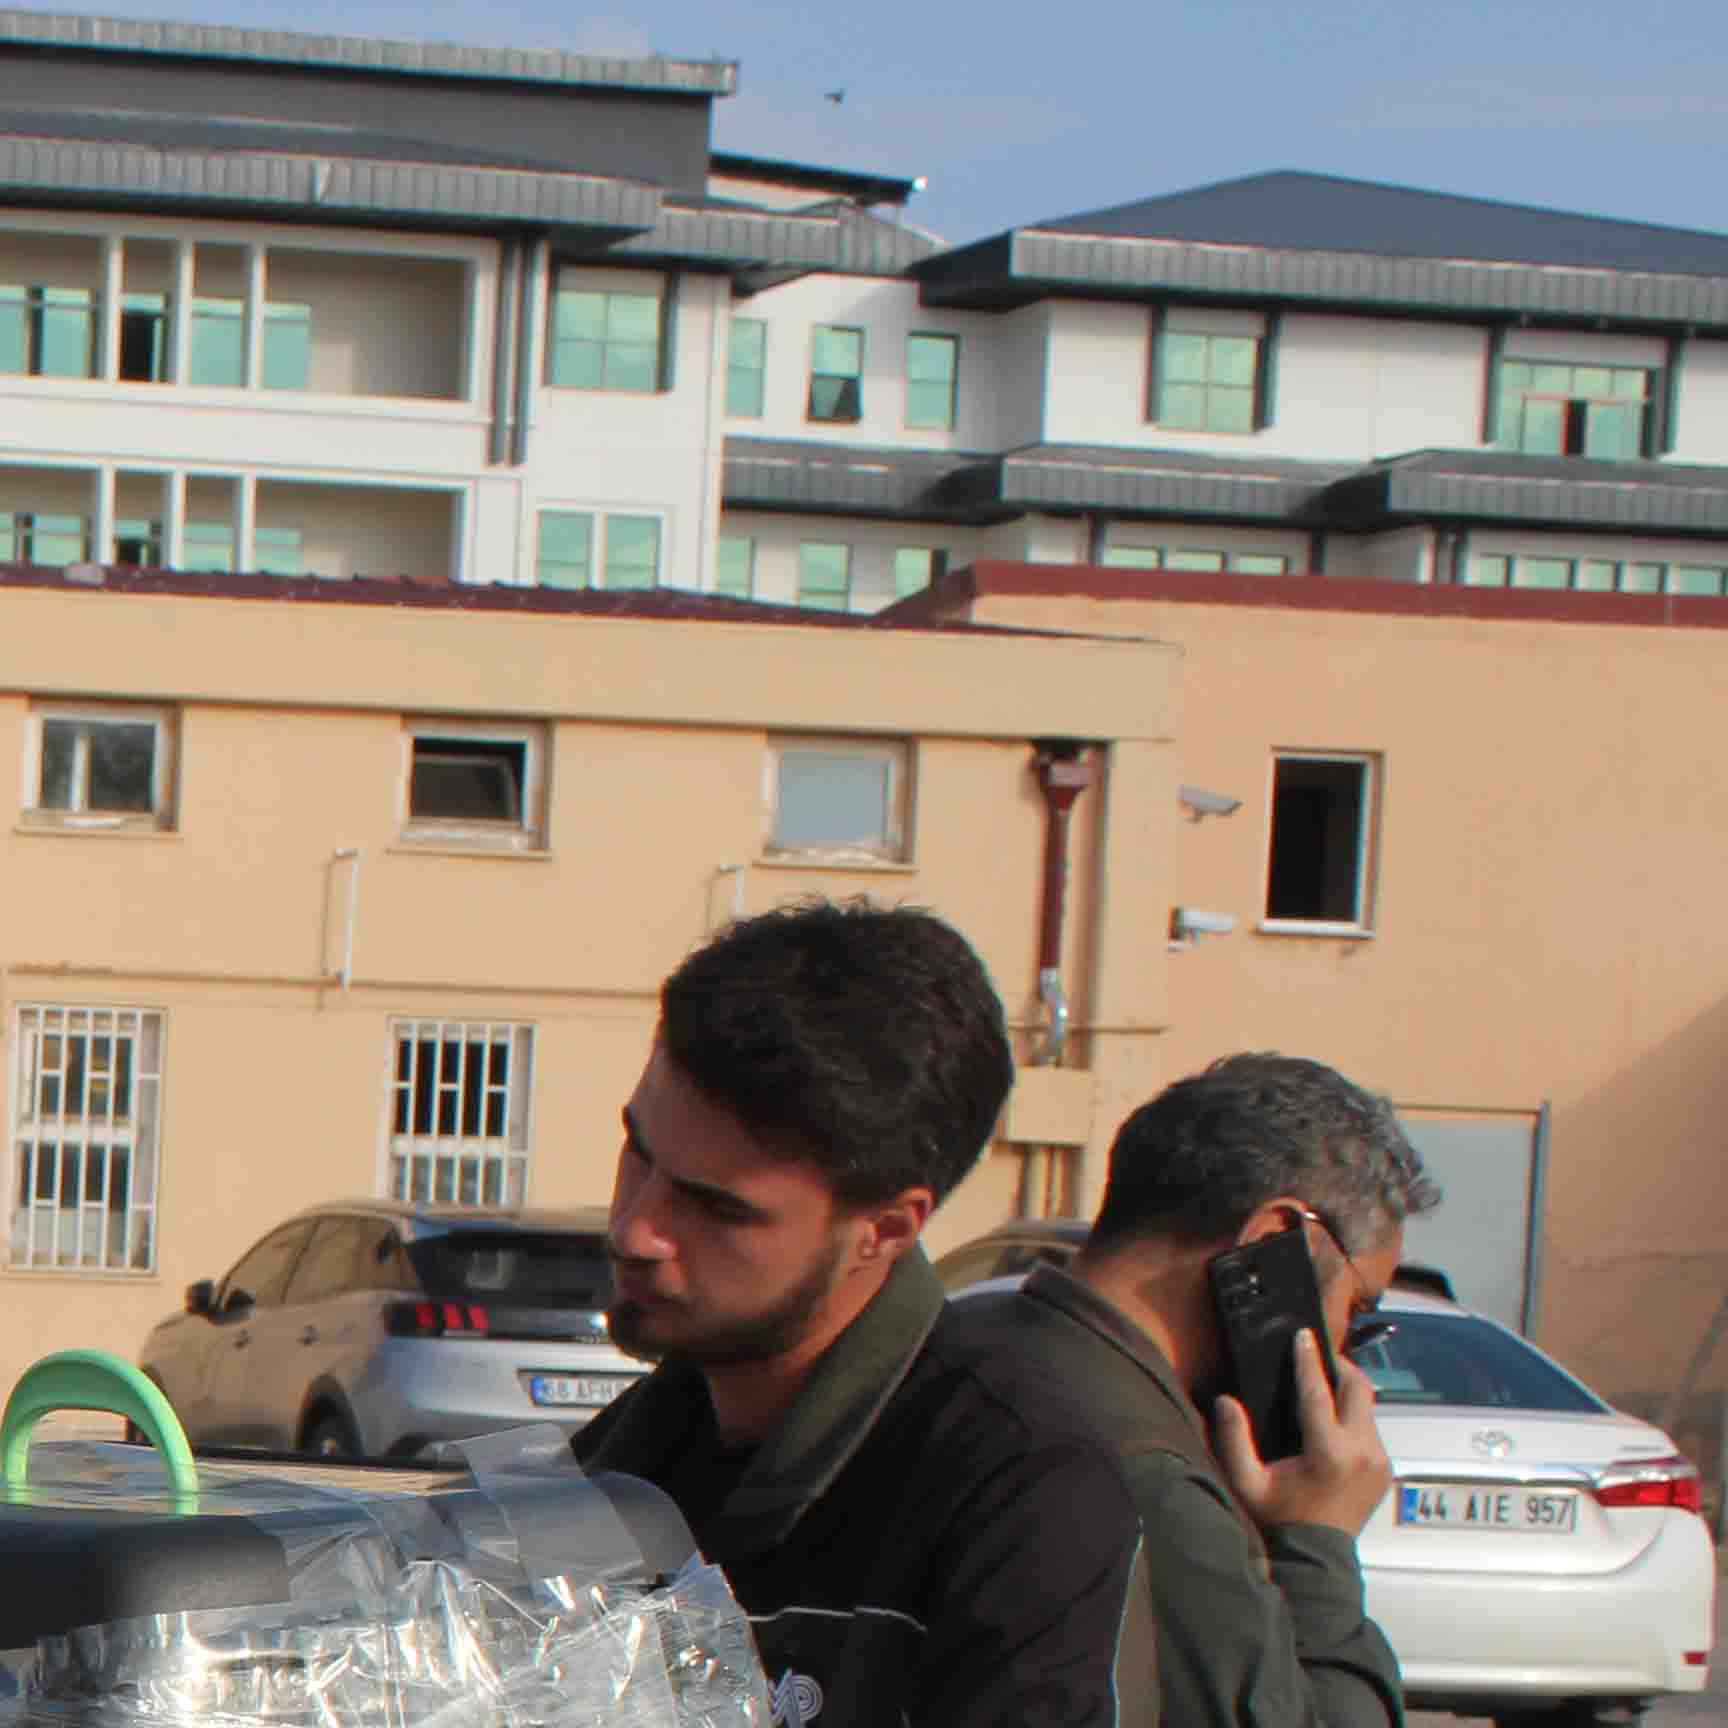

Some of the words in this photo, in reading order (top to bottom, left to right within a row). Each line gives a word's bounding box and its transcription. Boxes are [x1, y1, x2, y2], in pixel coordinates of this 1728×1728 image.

[1419, 1491, 1448, 1521] 44
[1465, 1493, 1512, 1522] AIE
[1525, 1495, 1570, 1524] 957
